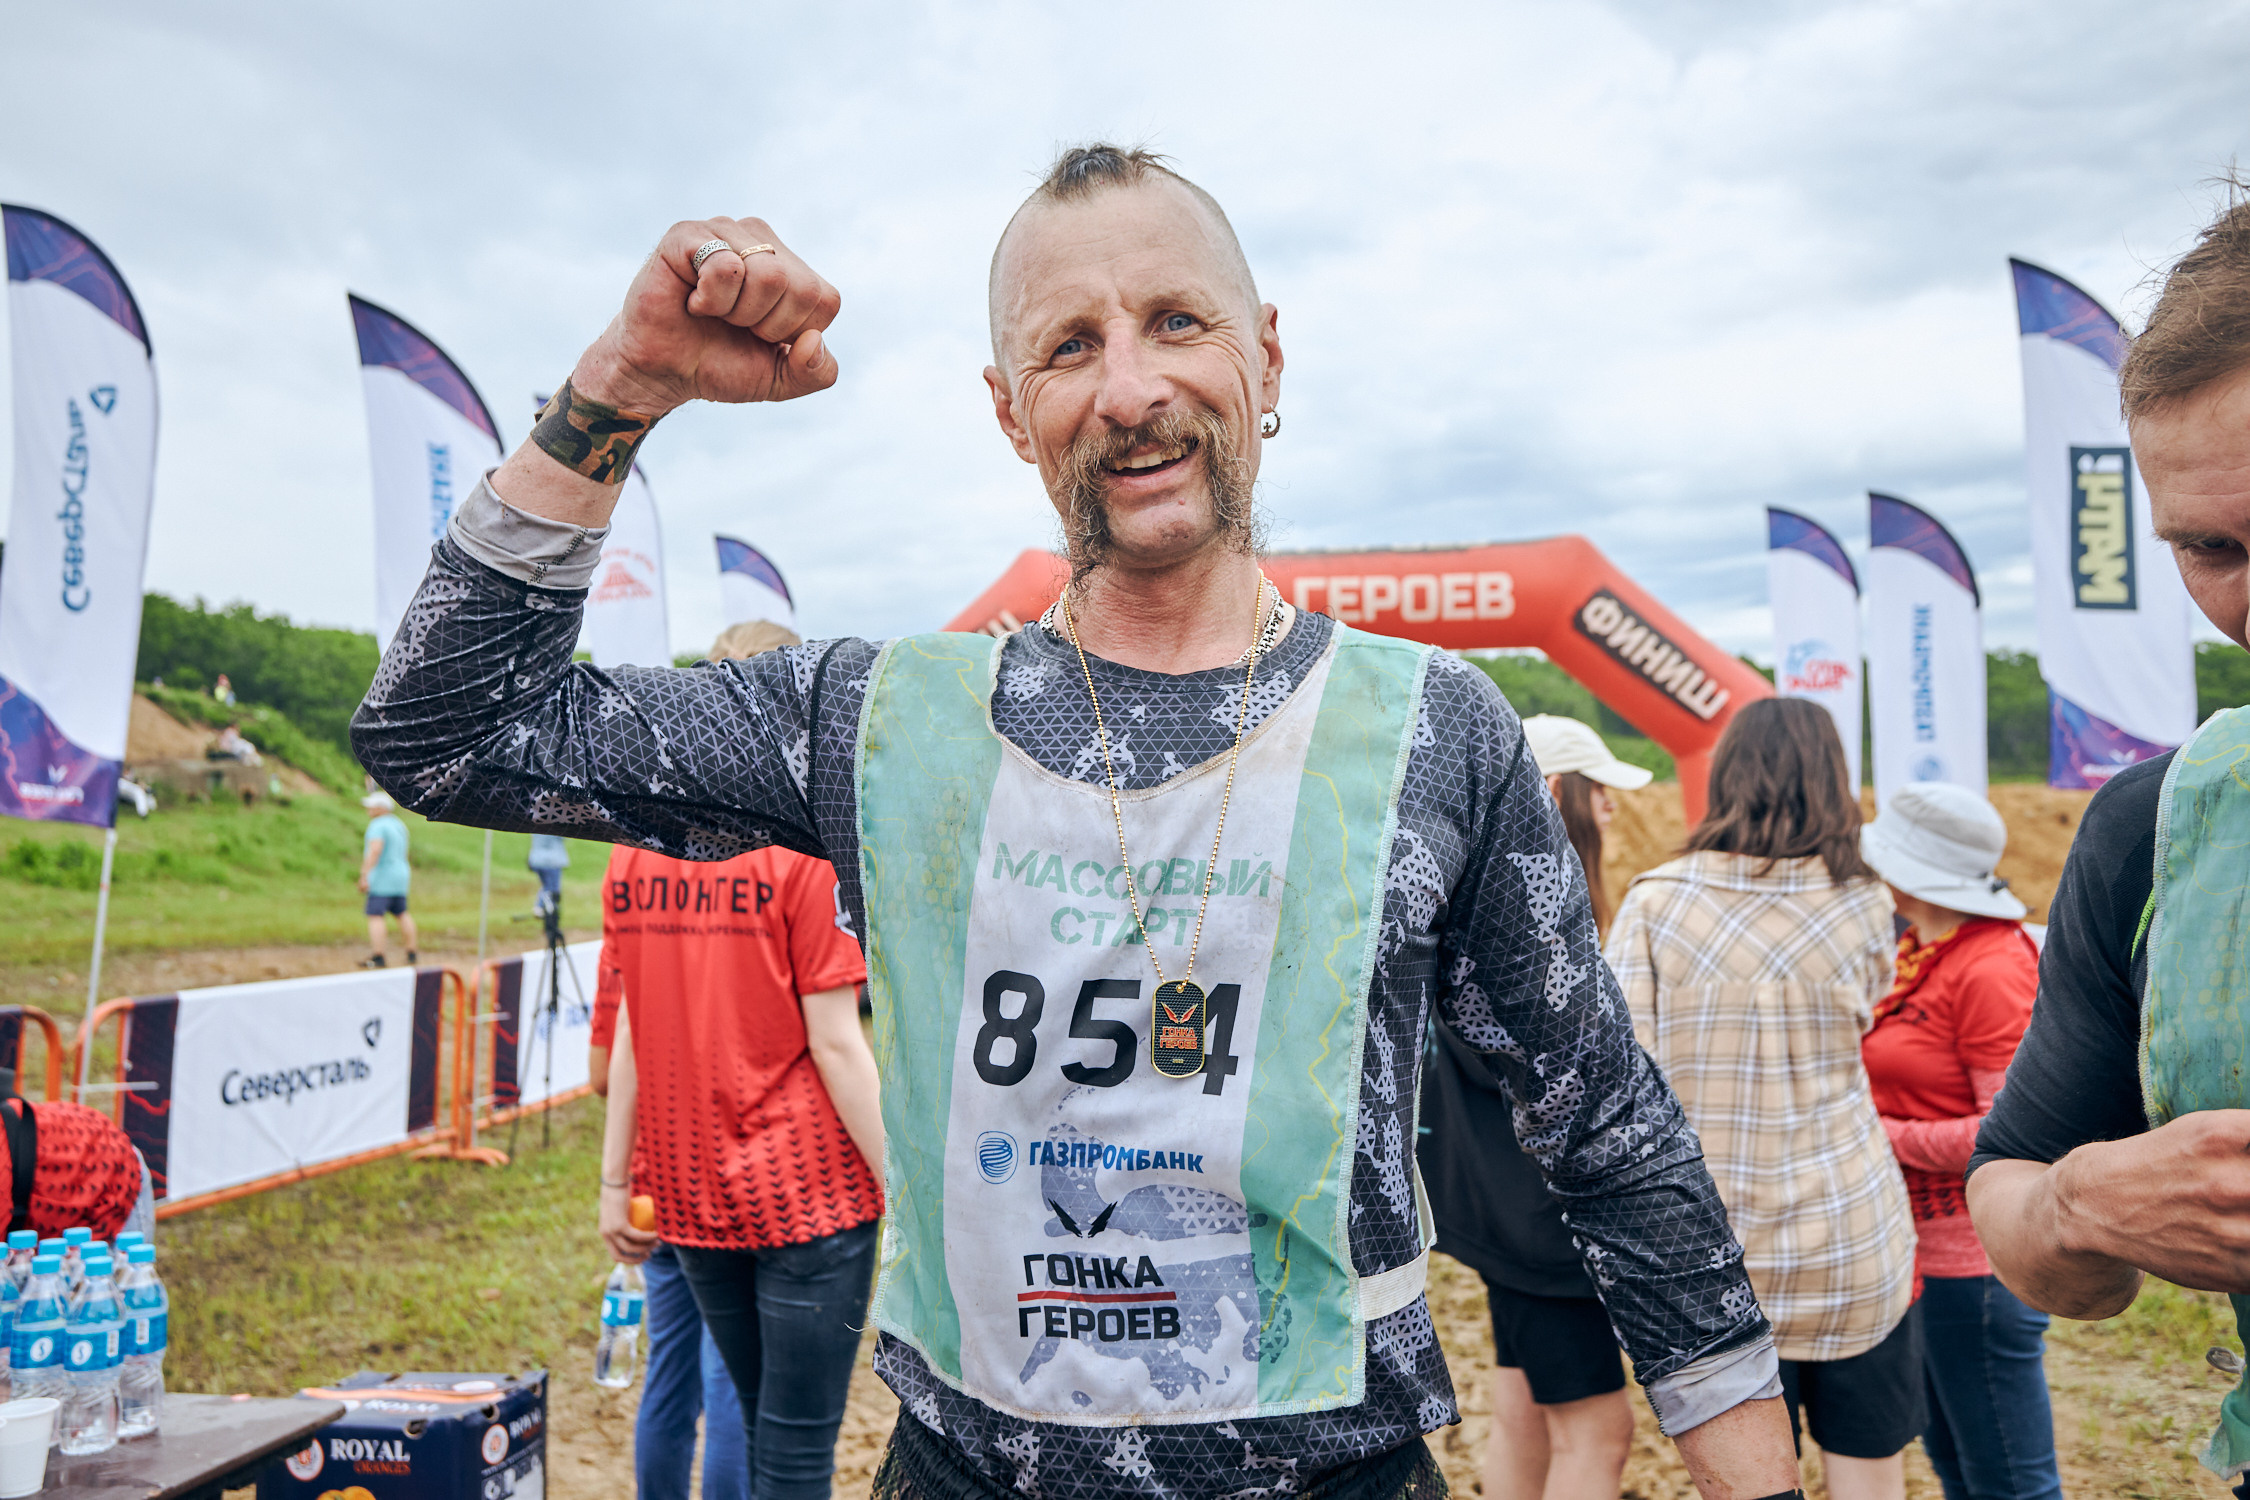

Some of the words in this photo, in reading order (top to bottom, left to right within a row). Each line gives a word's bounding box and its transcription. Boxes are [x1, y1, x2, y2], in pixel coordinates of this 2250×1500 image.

[1293, 572, 1517, 623] ГЕРОЕВ
[1580, 596, 1731, 722] ФИНИШ
[992, 842, 1272, 900] МАССОВЫЙ
[1050, 906, 1198, 947] СТАРТ
[973, 970, 1241, 1096] 854
[1160, 1039, 1197, 1049] ГЕРОЕВ
[1162, 1026, 1195, 1036] ГОНКА
[221, 1057, 370, 1105] Северсталь
[1029, 1141, 1204, 1174] ГАЗПРОМБАНК
[1023, 1254, 1164, 1288] ГОНКА
[1019, 1306, 1181, 1342] ГЕРОЕВ
[330, 1438, 411, 1461] ROYAL
